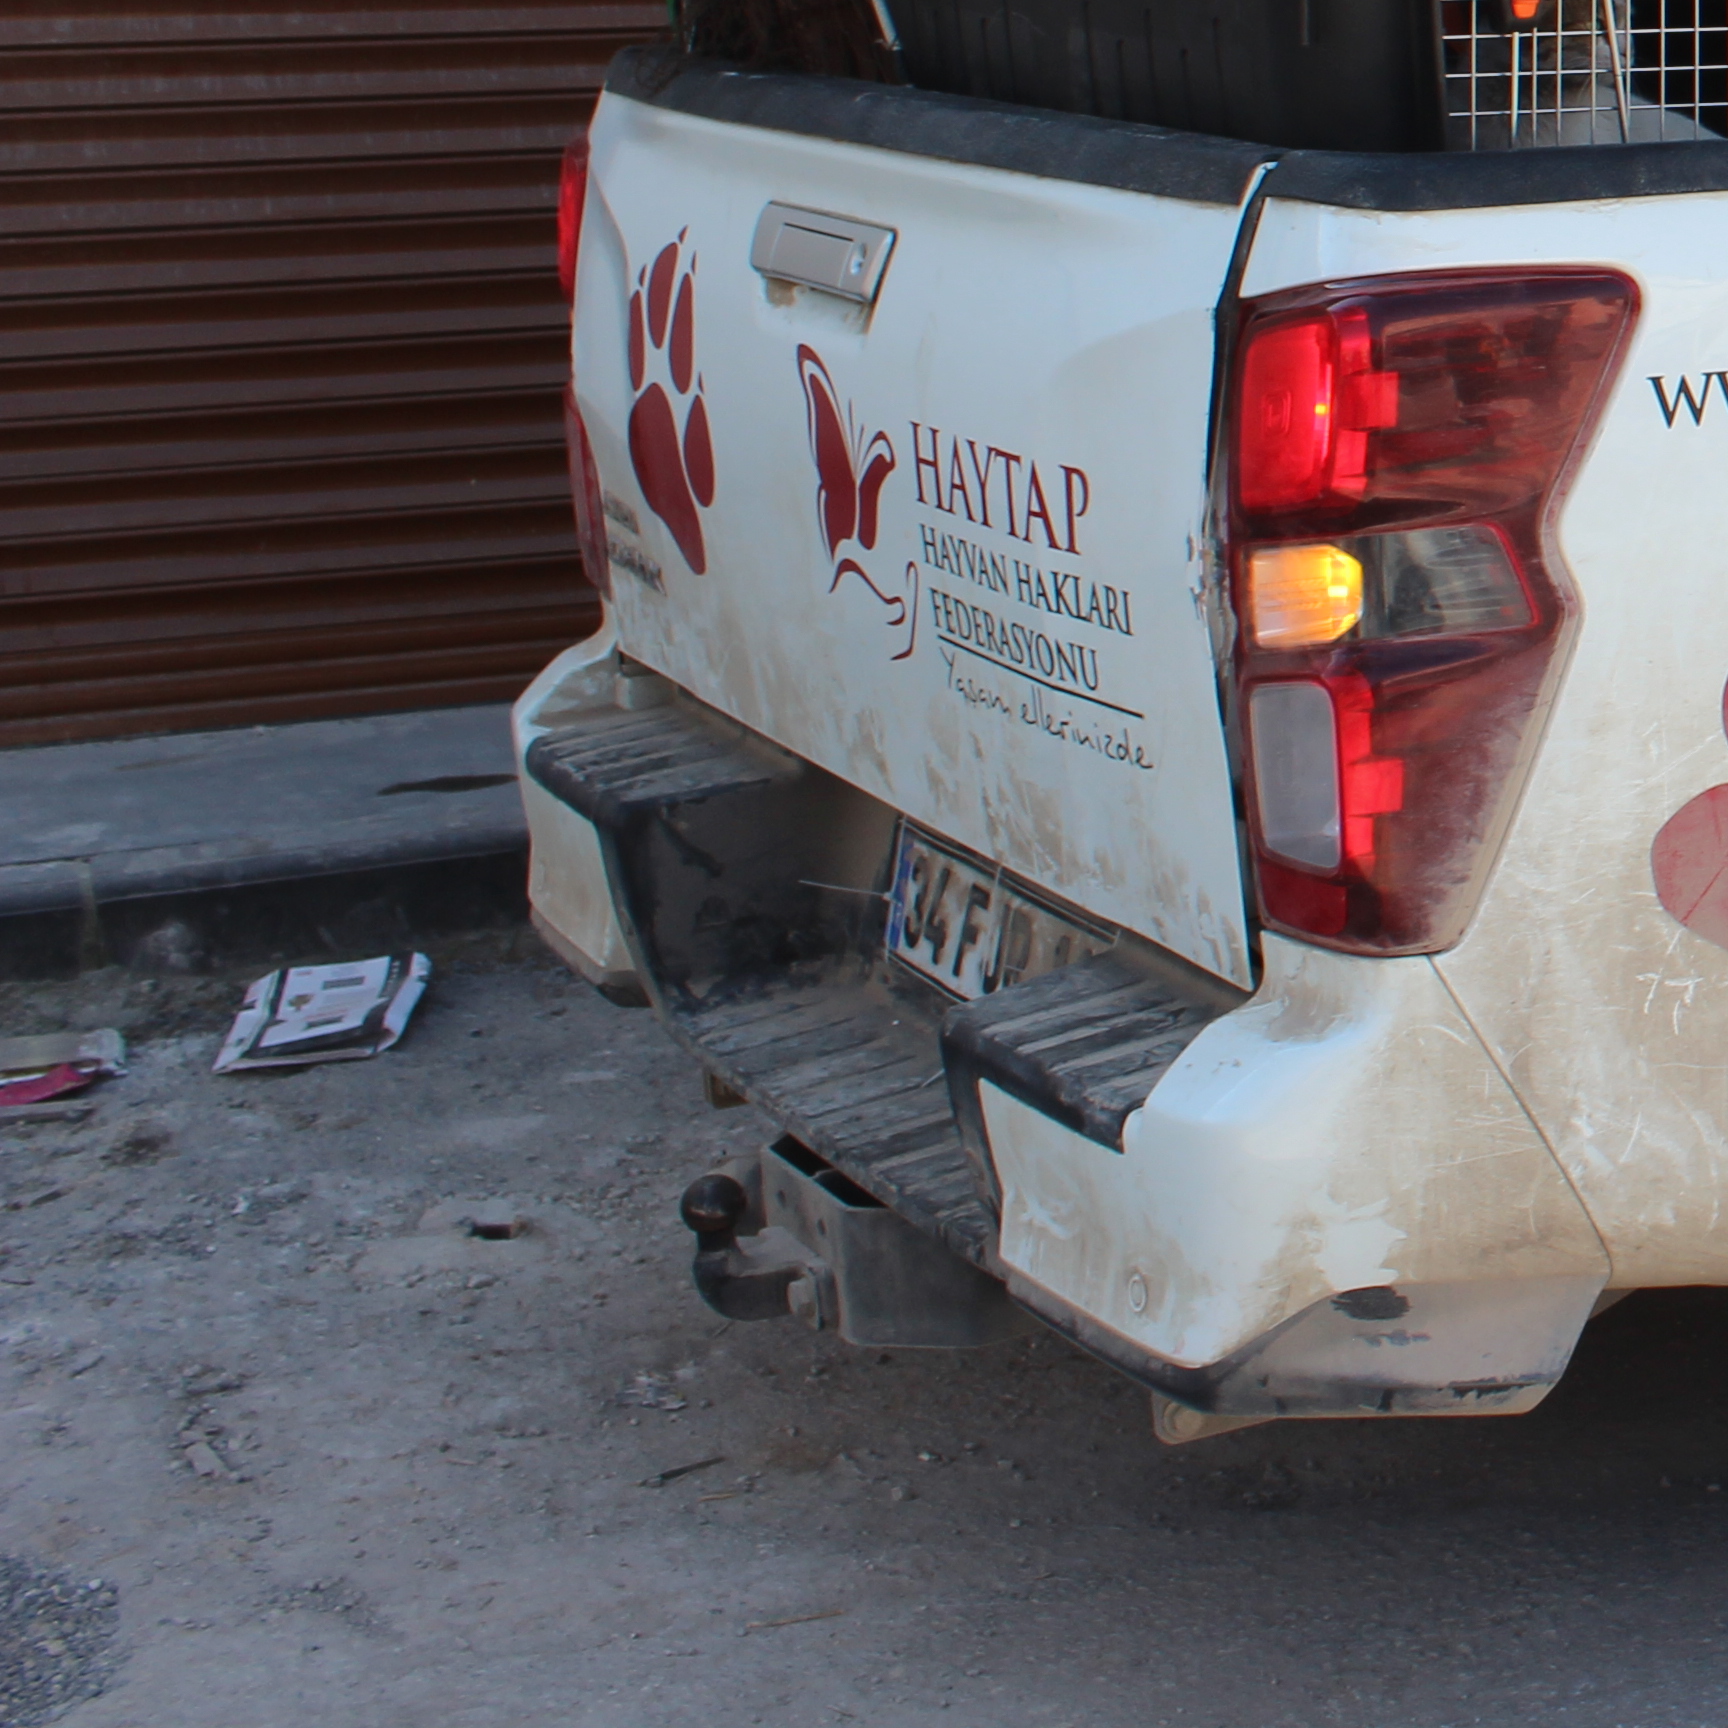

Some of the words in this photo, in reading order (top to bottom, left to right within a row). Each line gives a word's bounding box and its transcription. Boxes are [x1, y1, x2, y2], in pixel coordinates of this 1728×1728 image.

[910, 420, 1091, 556] HAYTAP
[919, 523, 1010, 597] HAYVAN
[1013, 558, 1135, 637] HAKLARI
[930, 587, 1100, 691] FEDERASYONU
[939, 646, 1012, 714] Yaşam
[1020, 684, 1154, 770] ellerinizde
[904, 852, 952, 967] 34
